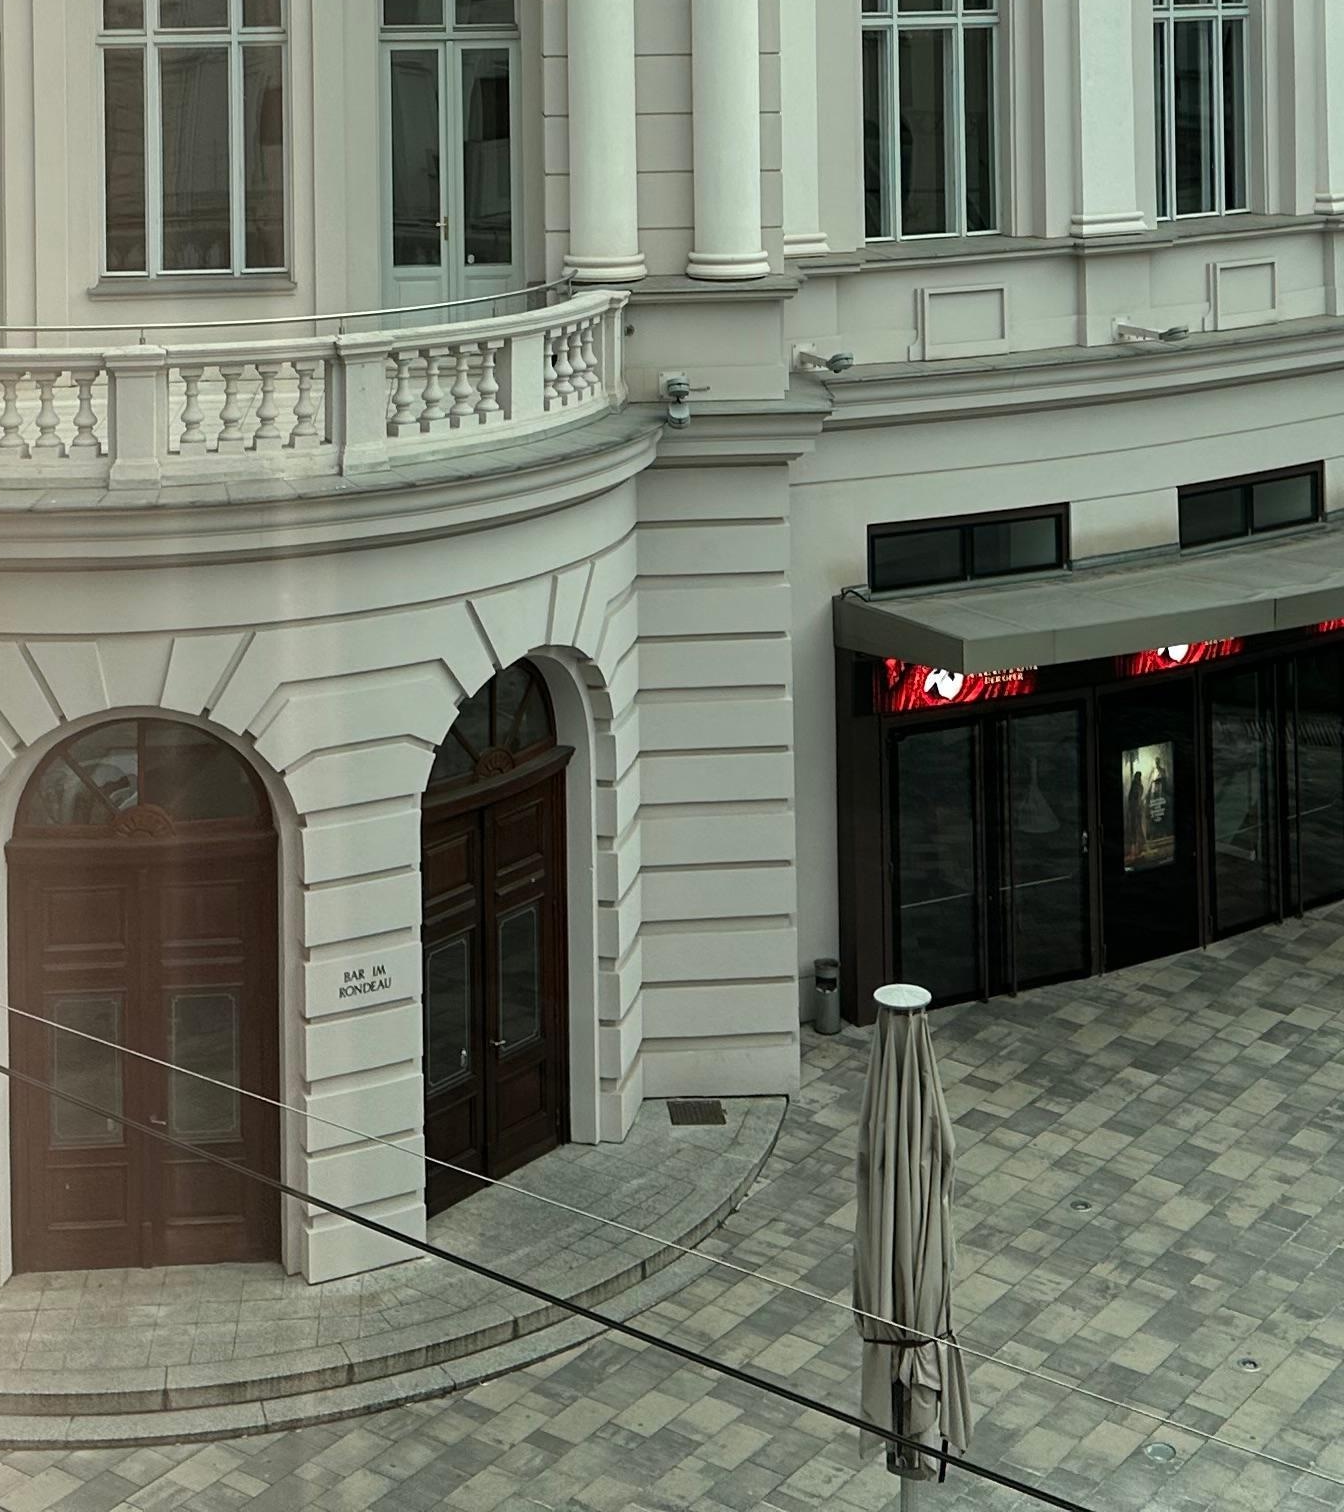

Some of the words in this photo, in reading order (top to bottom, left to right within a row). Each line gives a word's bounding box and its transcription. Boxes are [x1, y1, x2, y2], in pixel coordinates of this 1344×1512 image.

[343, 969, 365, 983] BAR
[372, 964, 386, 976] IM
[339, 977, 392, 999] RONDEAU
